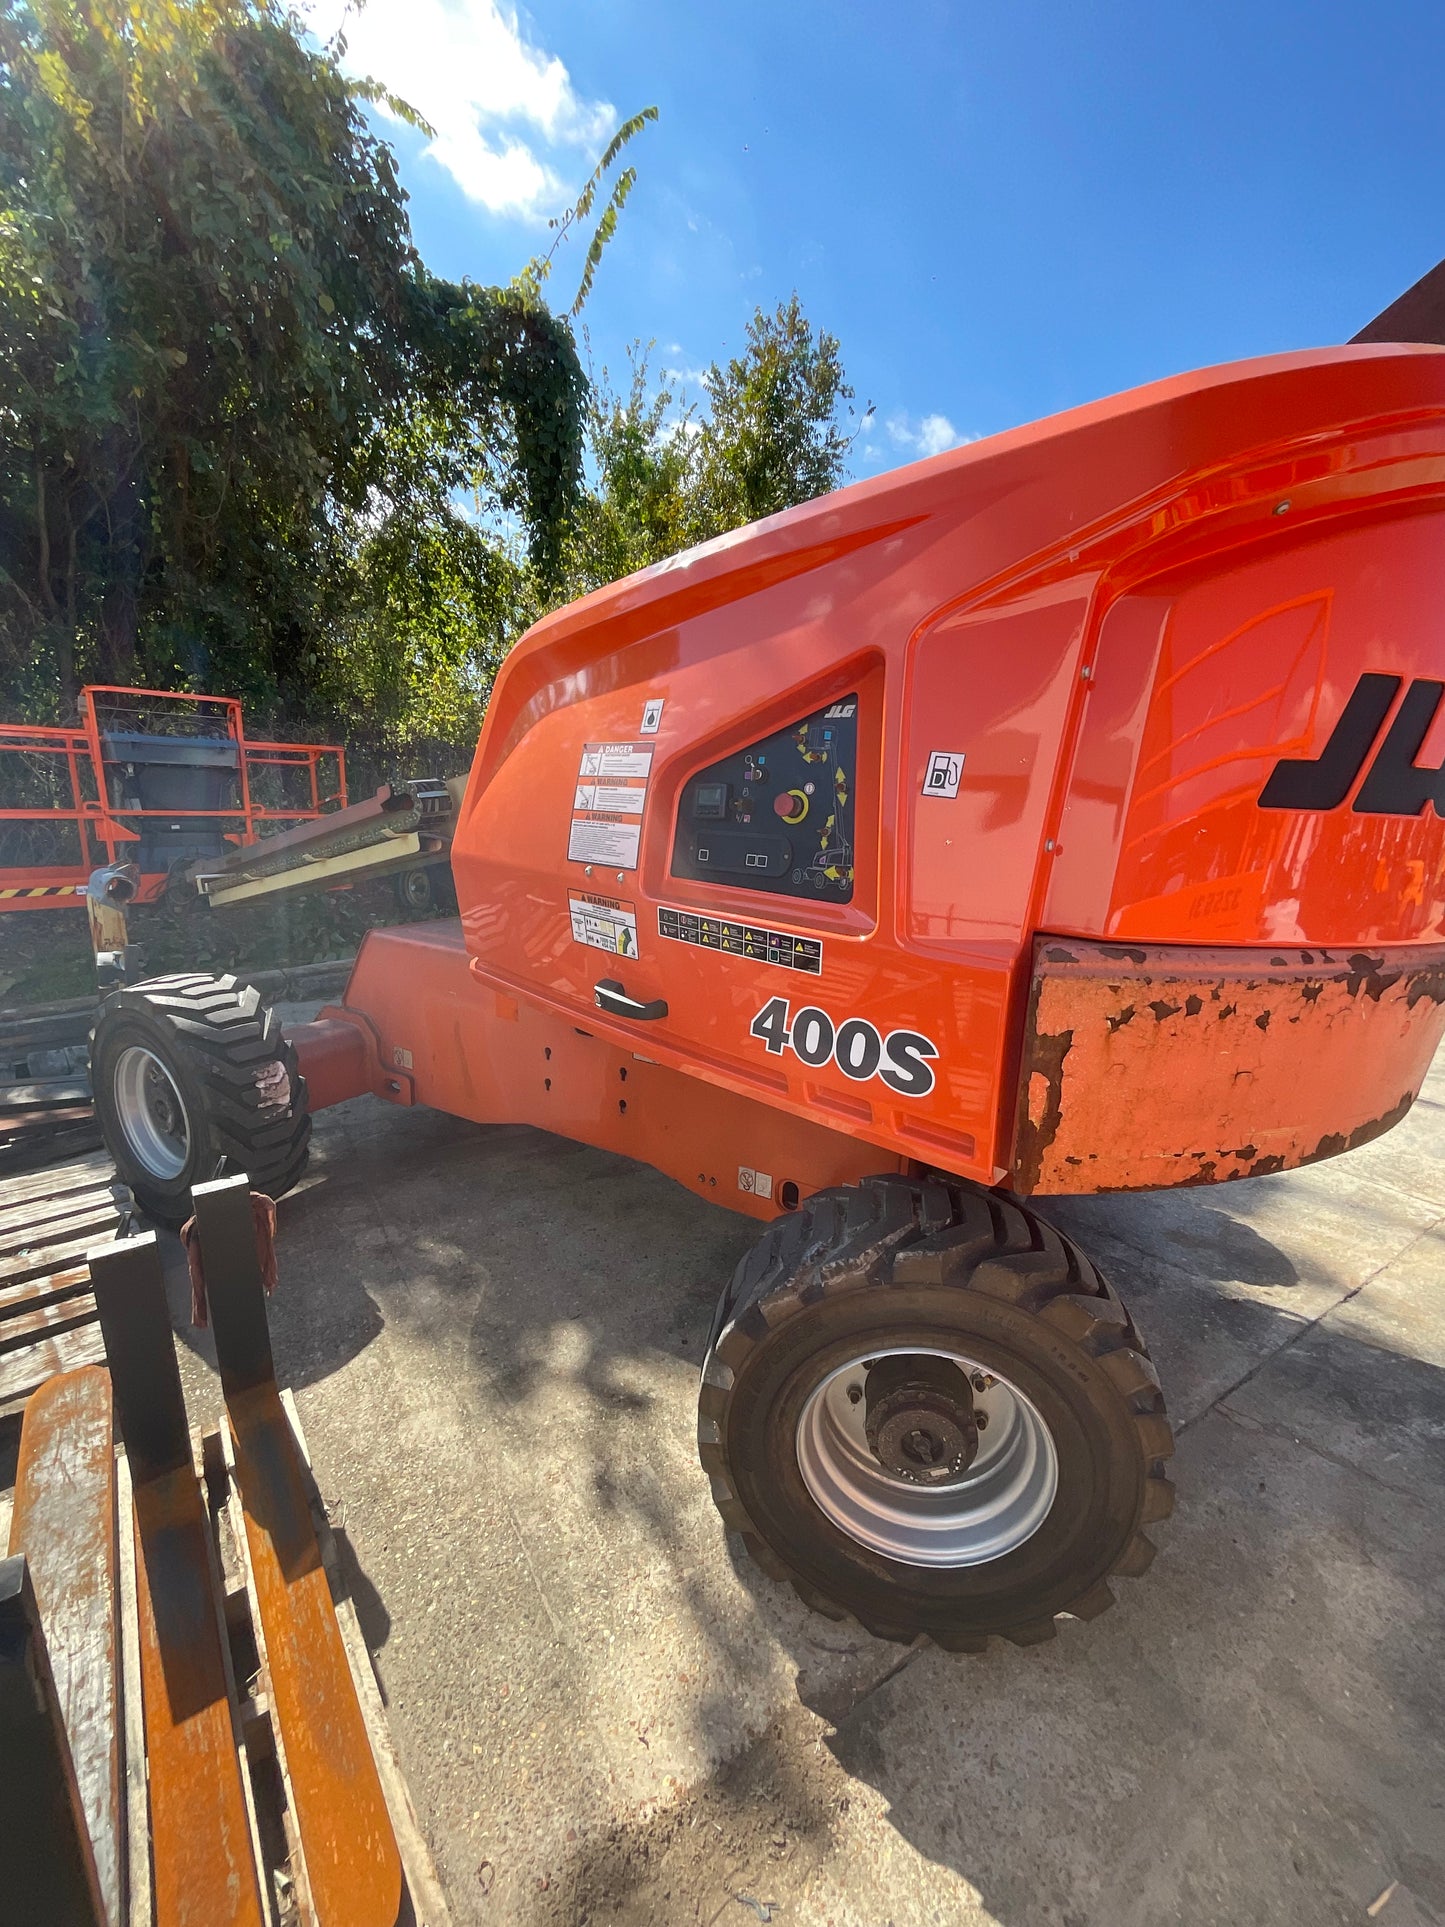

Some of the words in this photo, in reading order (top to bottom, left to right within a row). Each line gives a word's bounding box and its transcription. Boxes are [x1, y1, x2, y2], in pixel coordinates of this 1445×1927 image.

[824, 704, 856, 718] JLG
[605, 745, 633, 753] DANGER
[1257, 673, 1445, 818] JL
[597, 778, 628, 786] WARNING
[592, 813, 622, 823] WARNING
[587, 896, 620, 910] WARNING
[750, 996, 939, 1097] 400S
